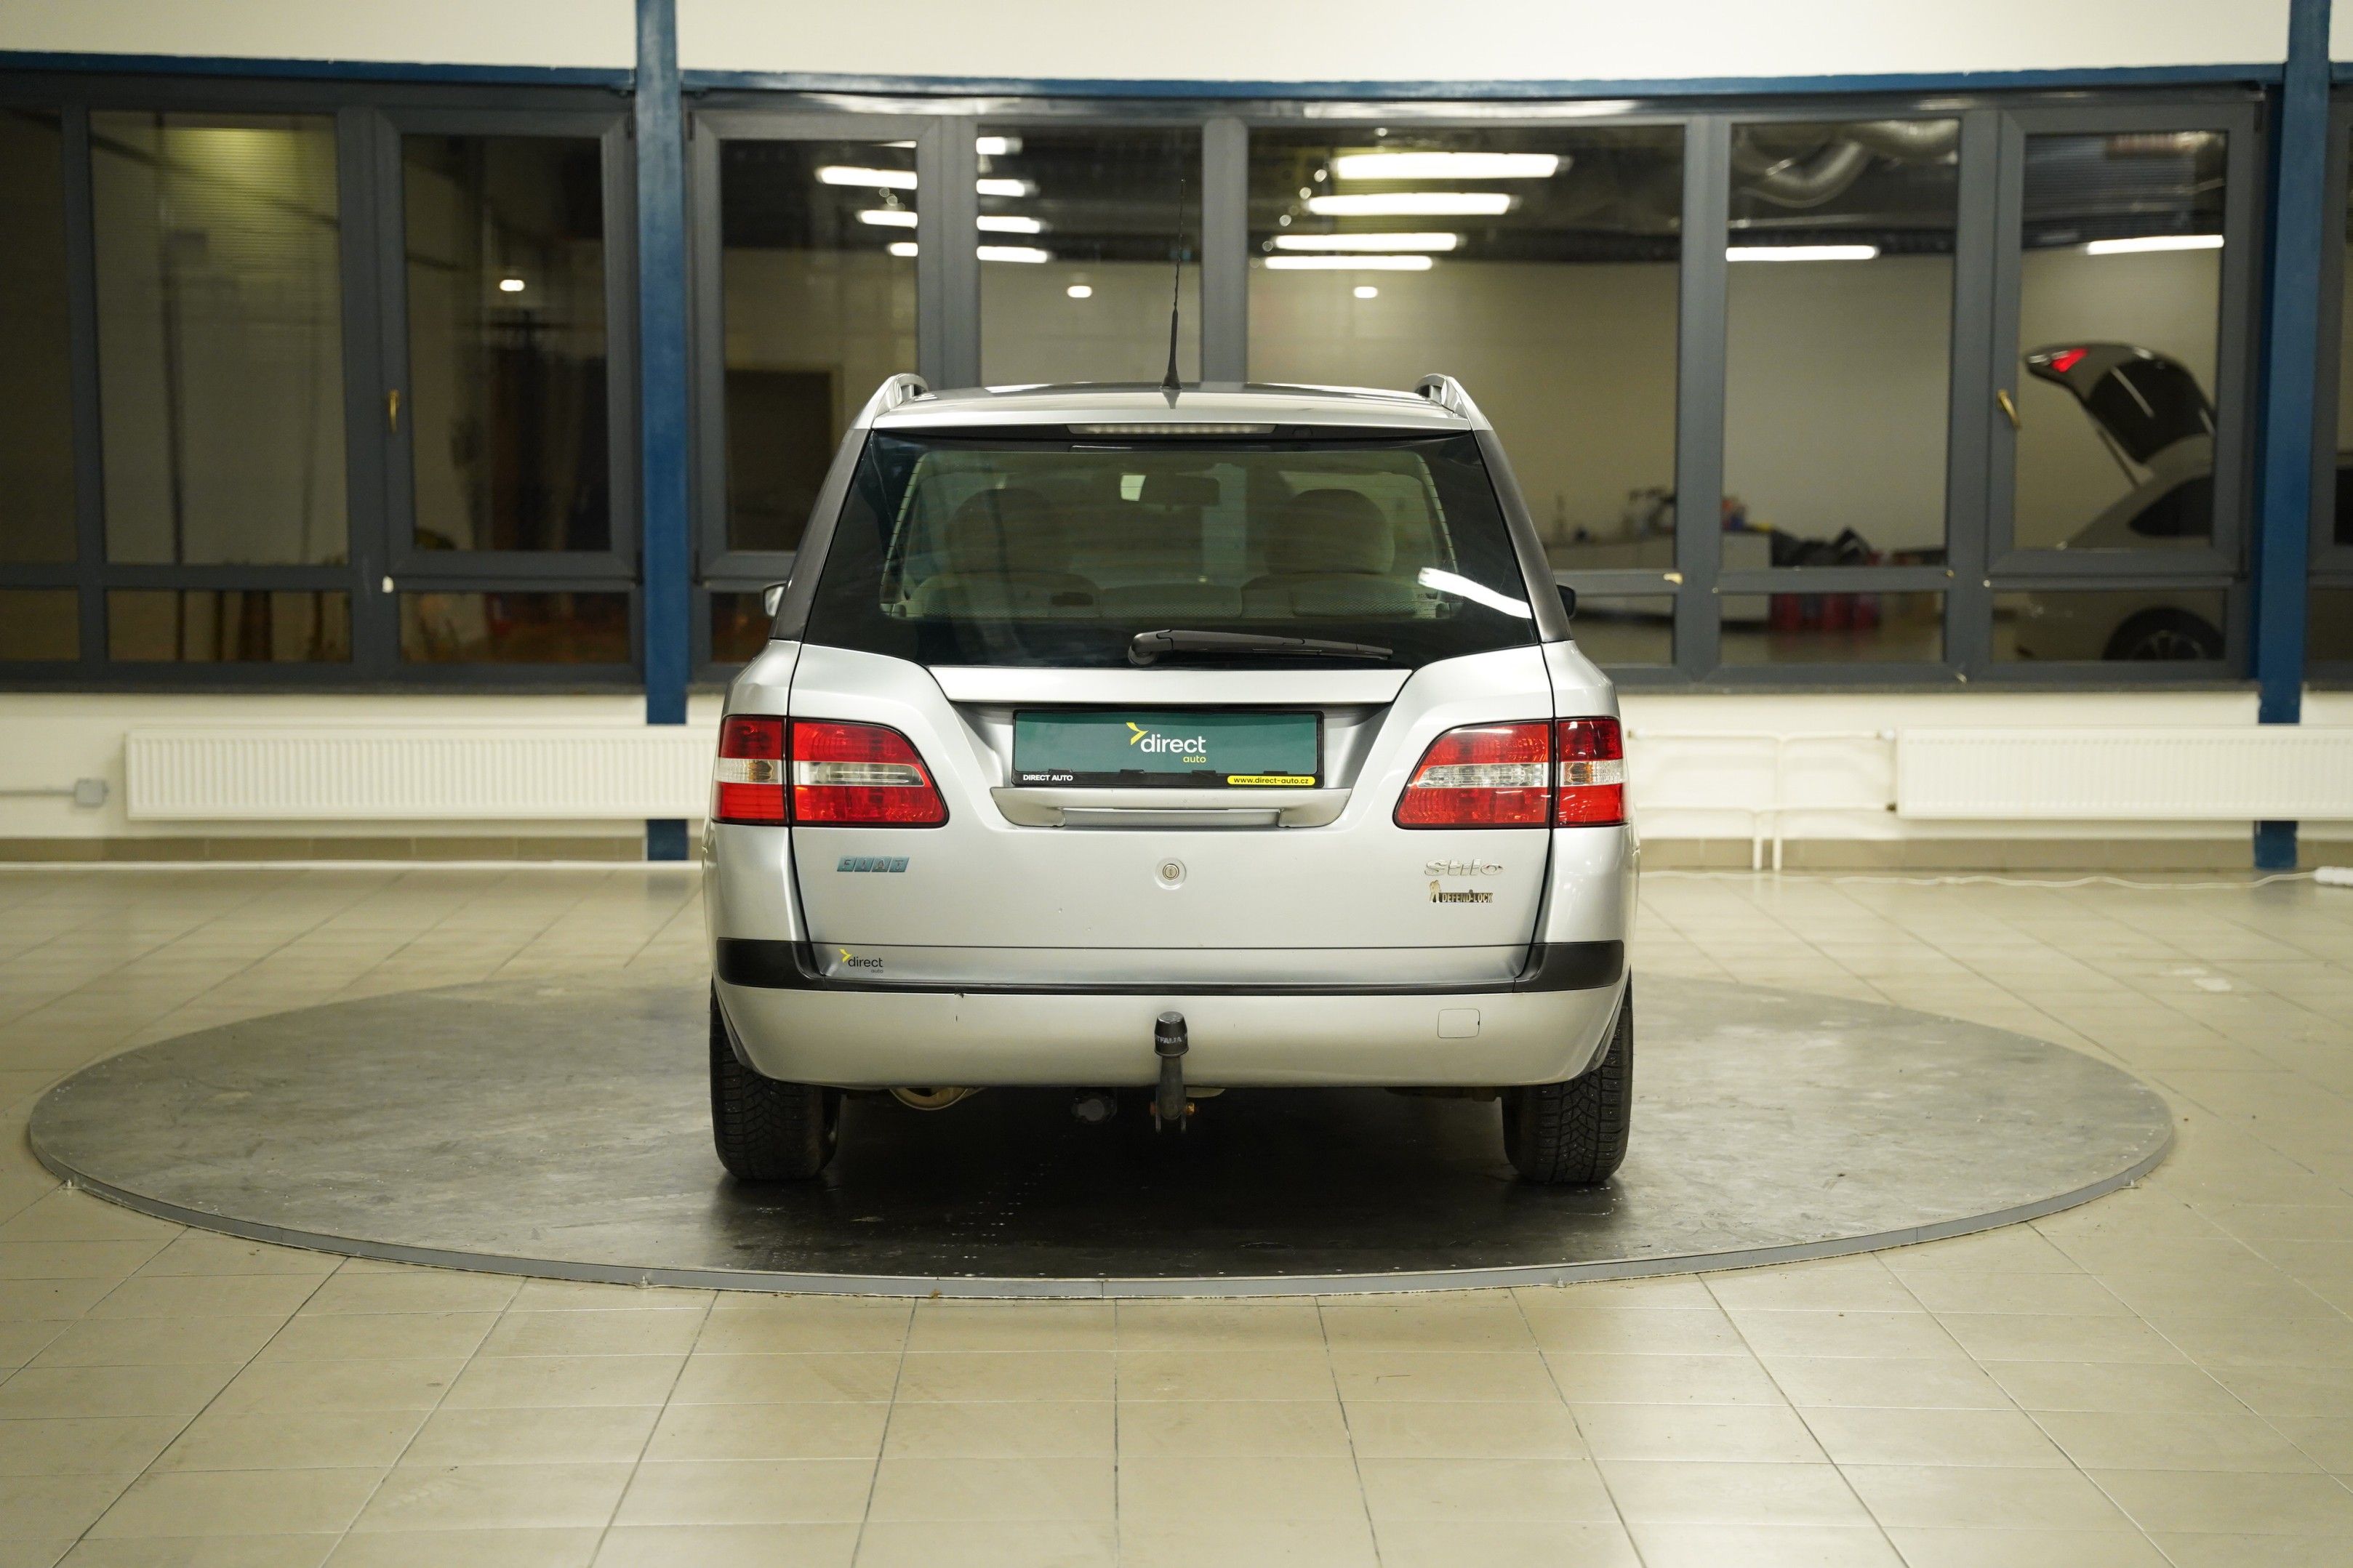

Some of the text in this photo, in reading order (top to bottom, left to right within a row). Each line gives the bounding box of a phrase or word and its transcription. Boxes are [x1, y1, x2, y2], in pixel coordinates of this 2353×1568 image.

[1140, 733, 1206, 753] direct
[842, 858, 905, 872] FIAT
[848, 956, 883, 968] direct
